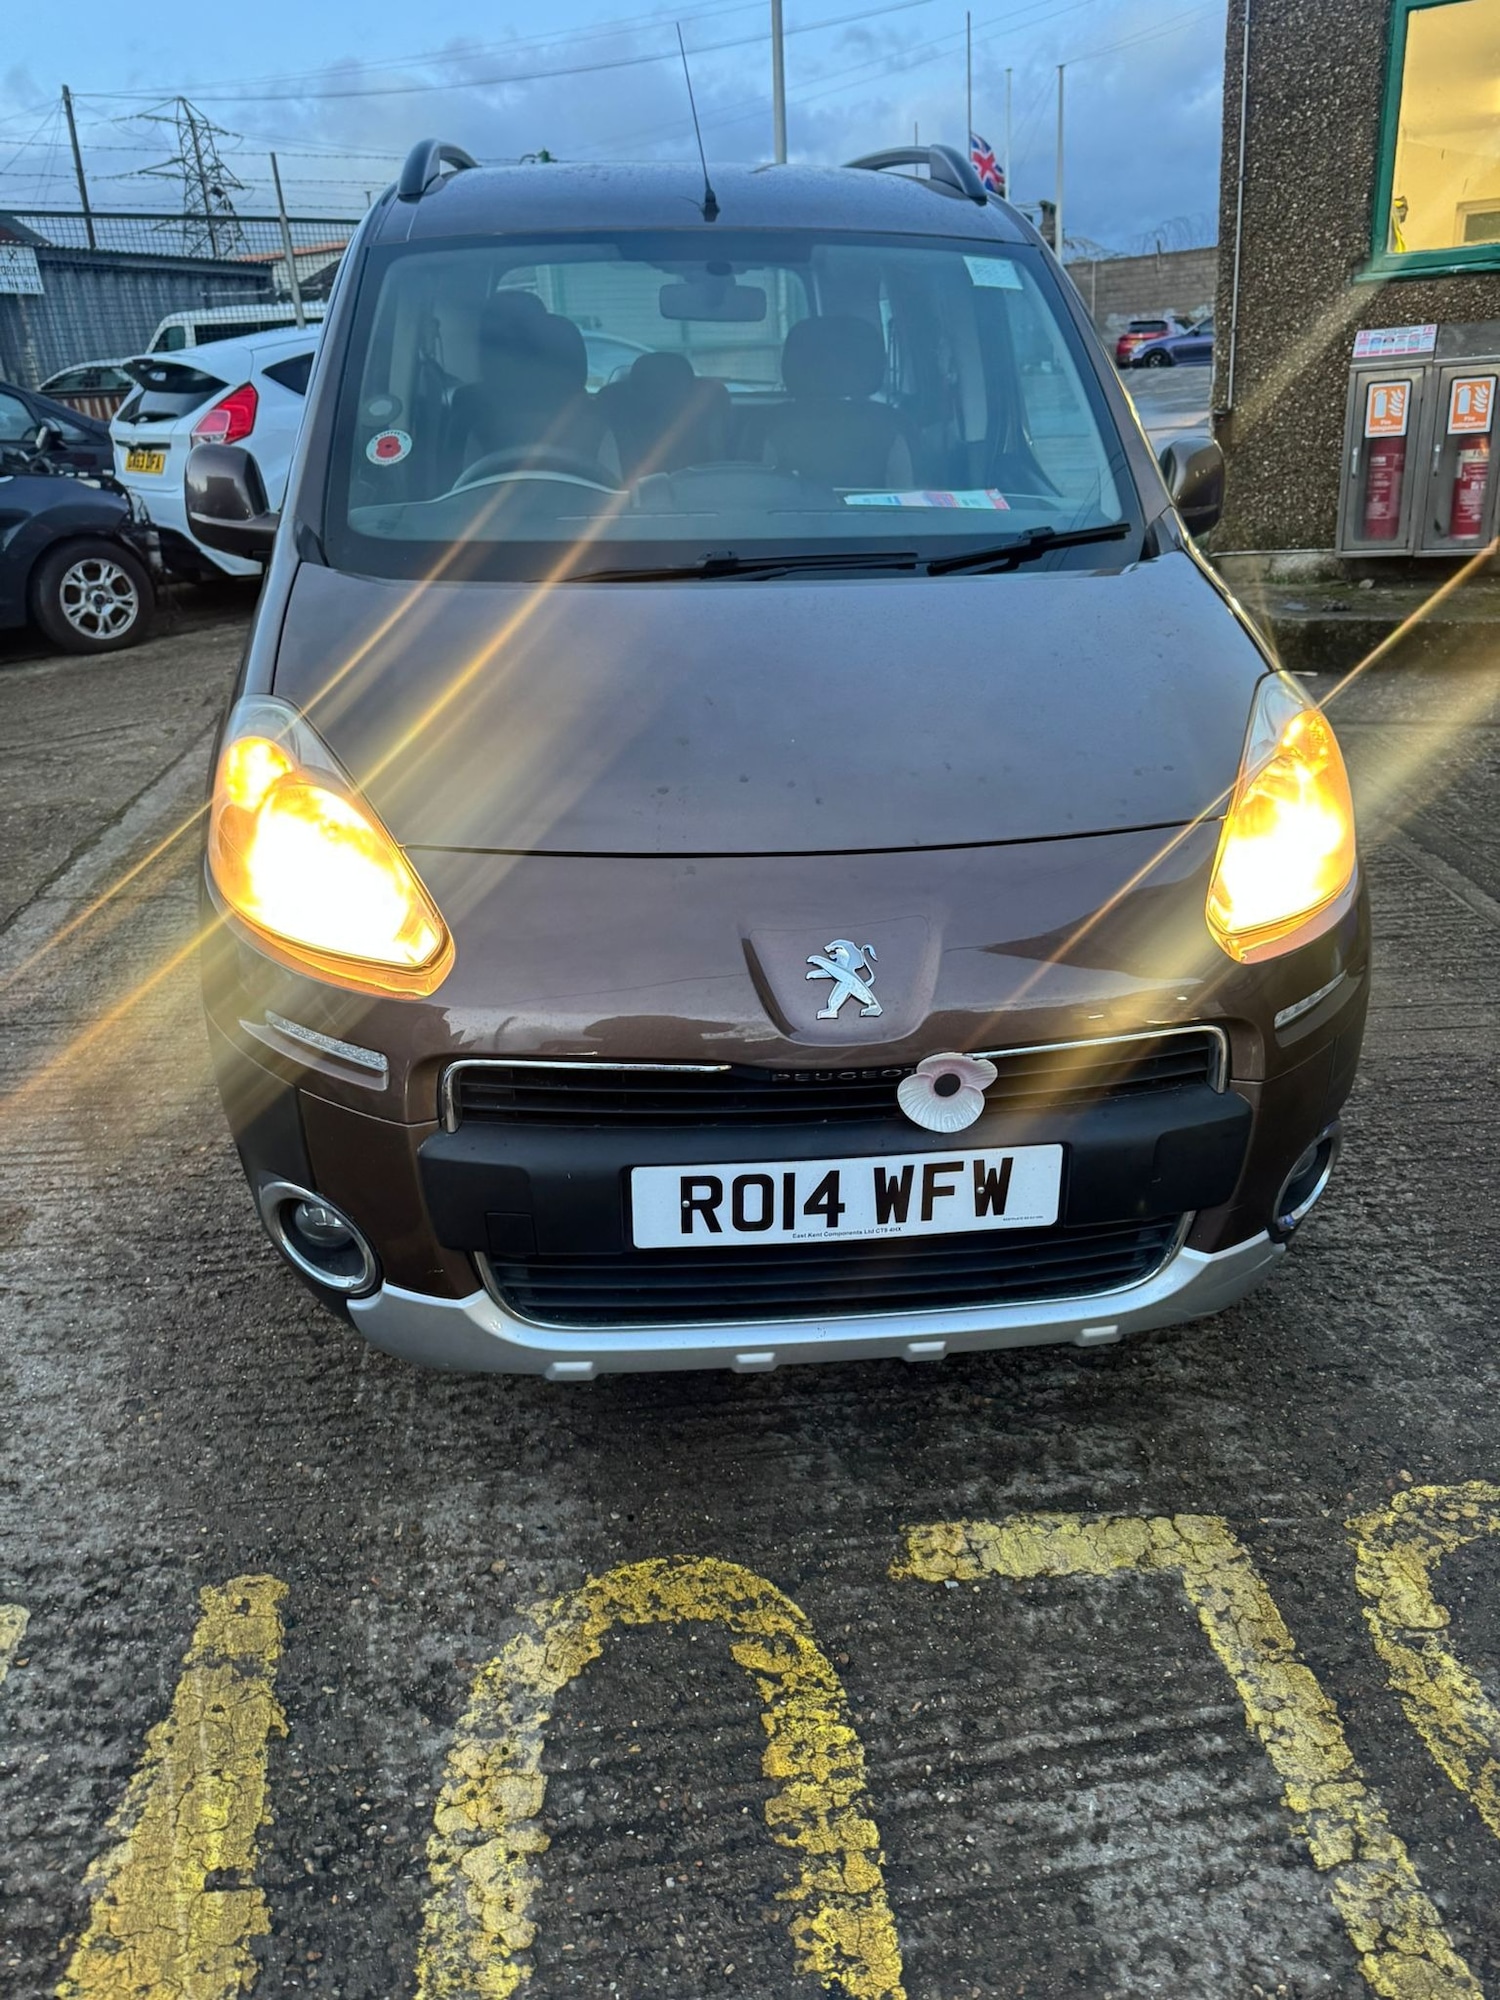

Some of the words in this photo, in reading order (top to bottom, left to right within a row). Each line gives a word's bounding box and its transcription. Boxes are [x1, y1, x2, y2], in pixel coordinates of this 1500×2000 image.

[680, 1169, 845, 1234] RO14
[873, 1156, 1014, 1224] WFW
[823, 1229, 863, 1238] Components
